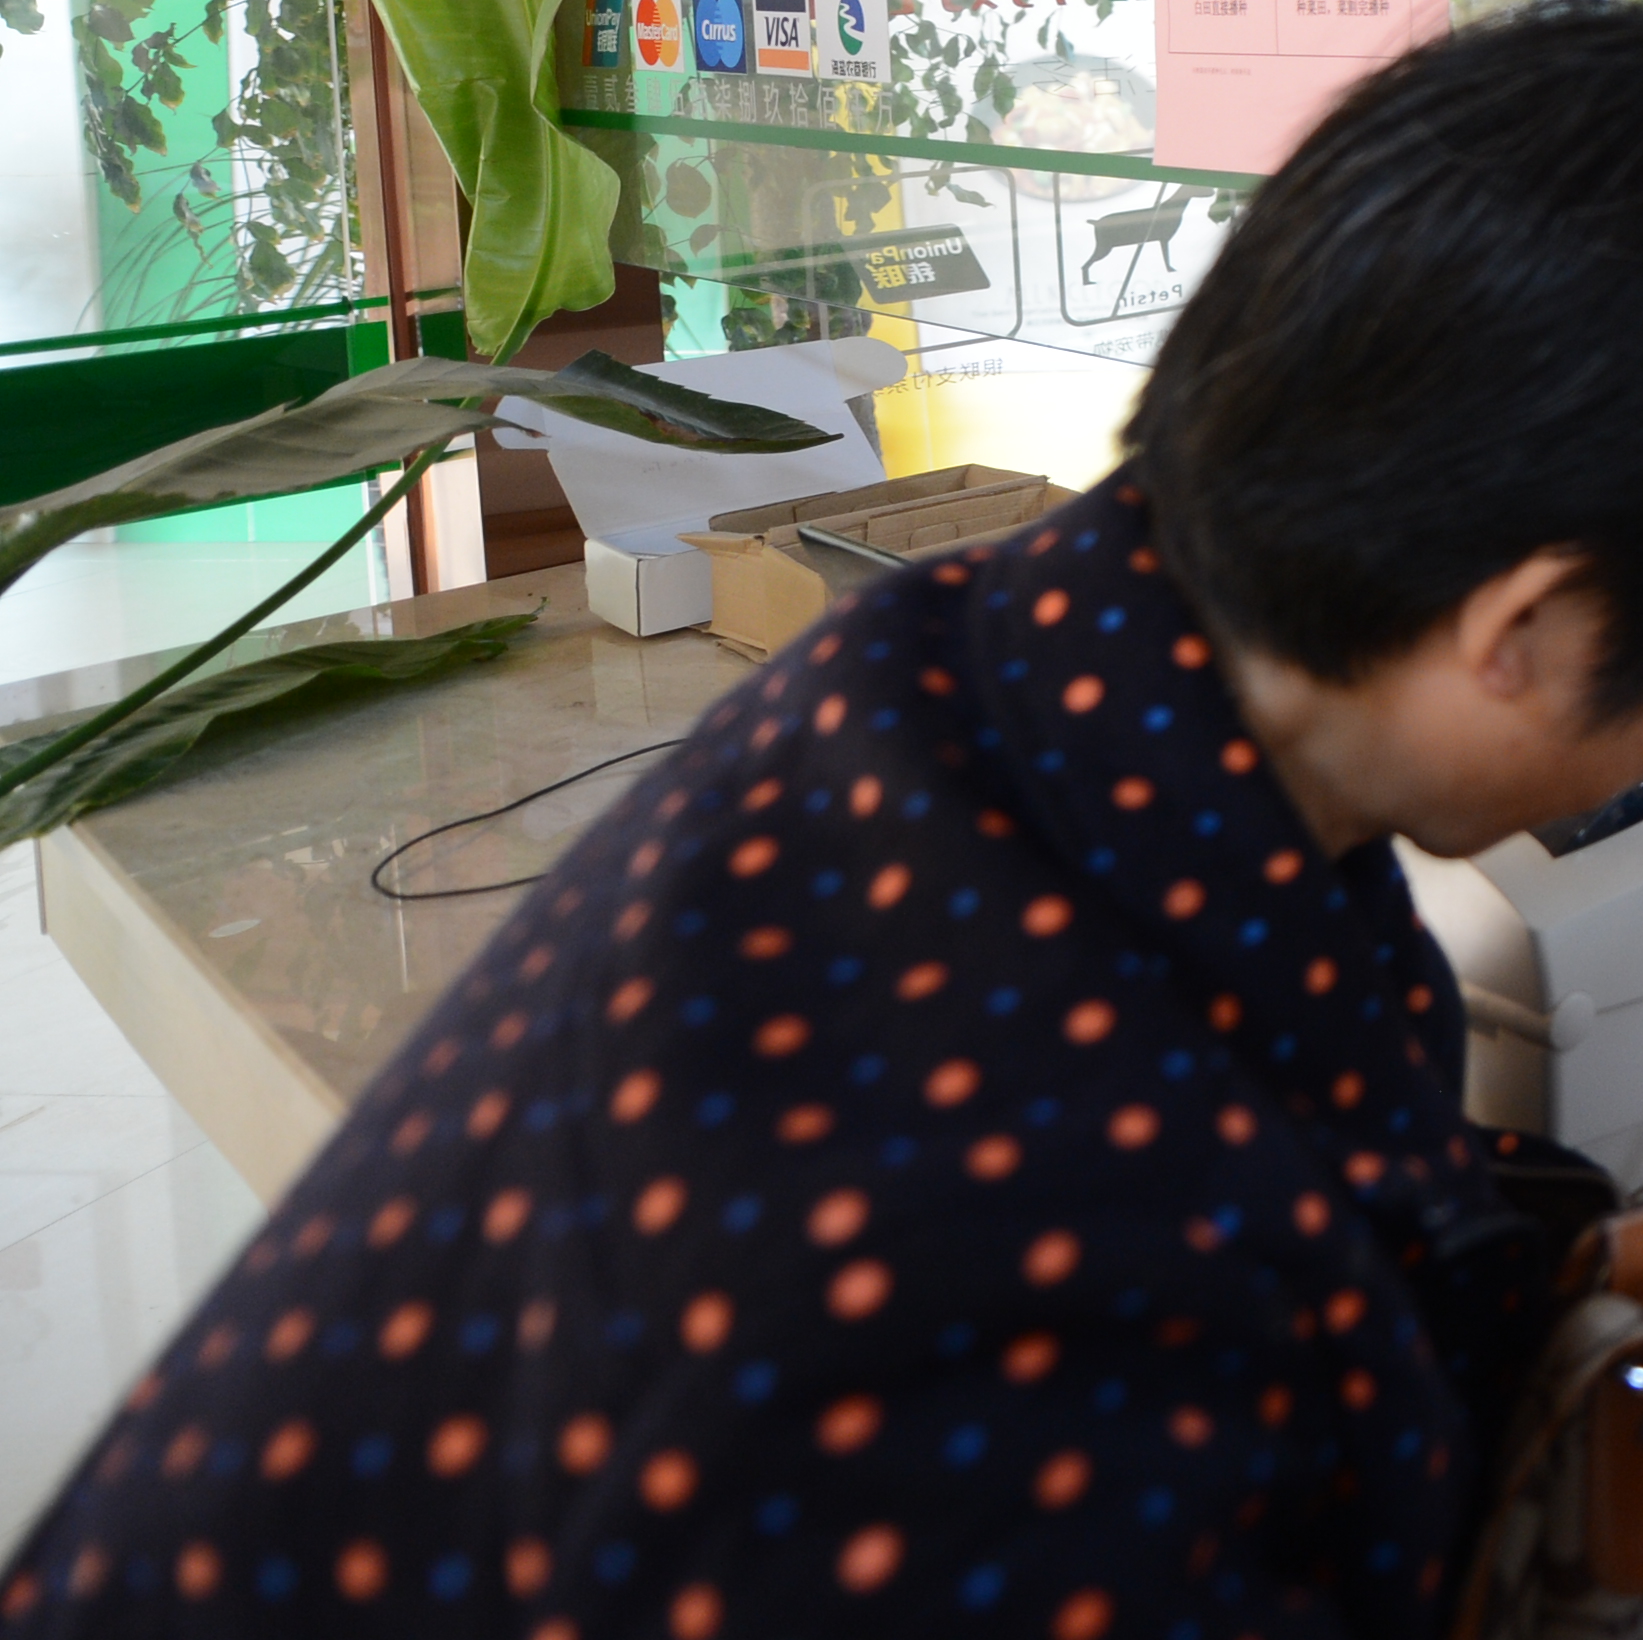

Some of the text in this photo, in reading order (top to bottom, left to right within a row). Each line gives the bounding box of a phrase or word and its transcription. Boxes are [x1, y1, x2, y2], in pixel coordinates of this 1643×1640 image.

[586, 8, 620, 32] UnionPay
[702, 19, 736, 42] Cirrus
[637, 23, 678, 41] MasterCard
[764, 16, 800, 48] VISA
